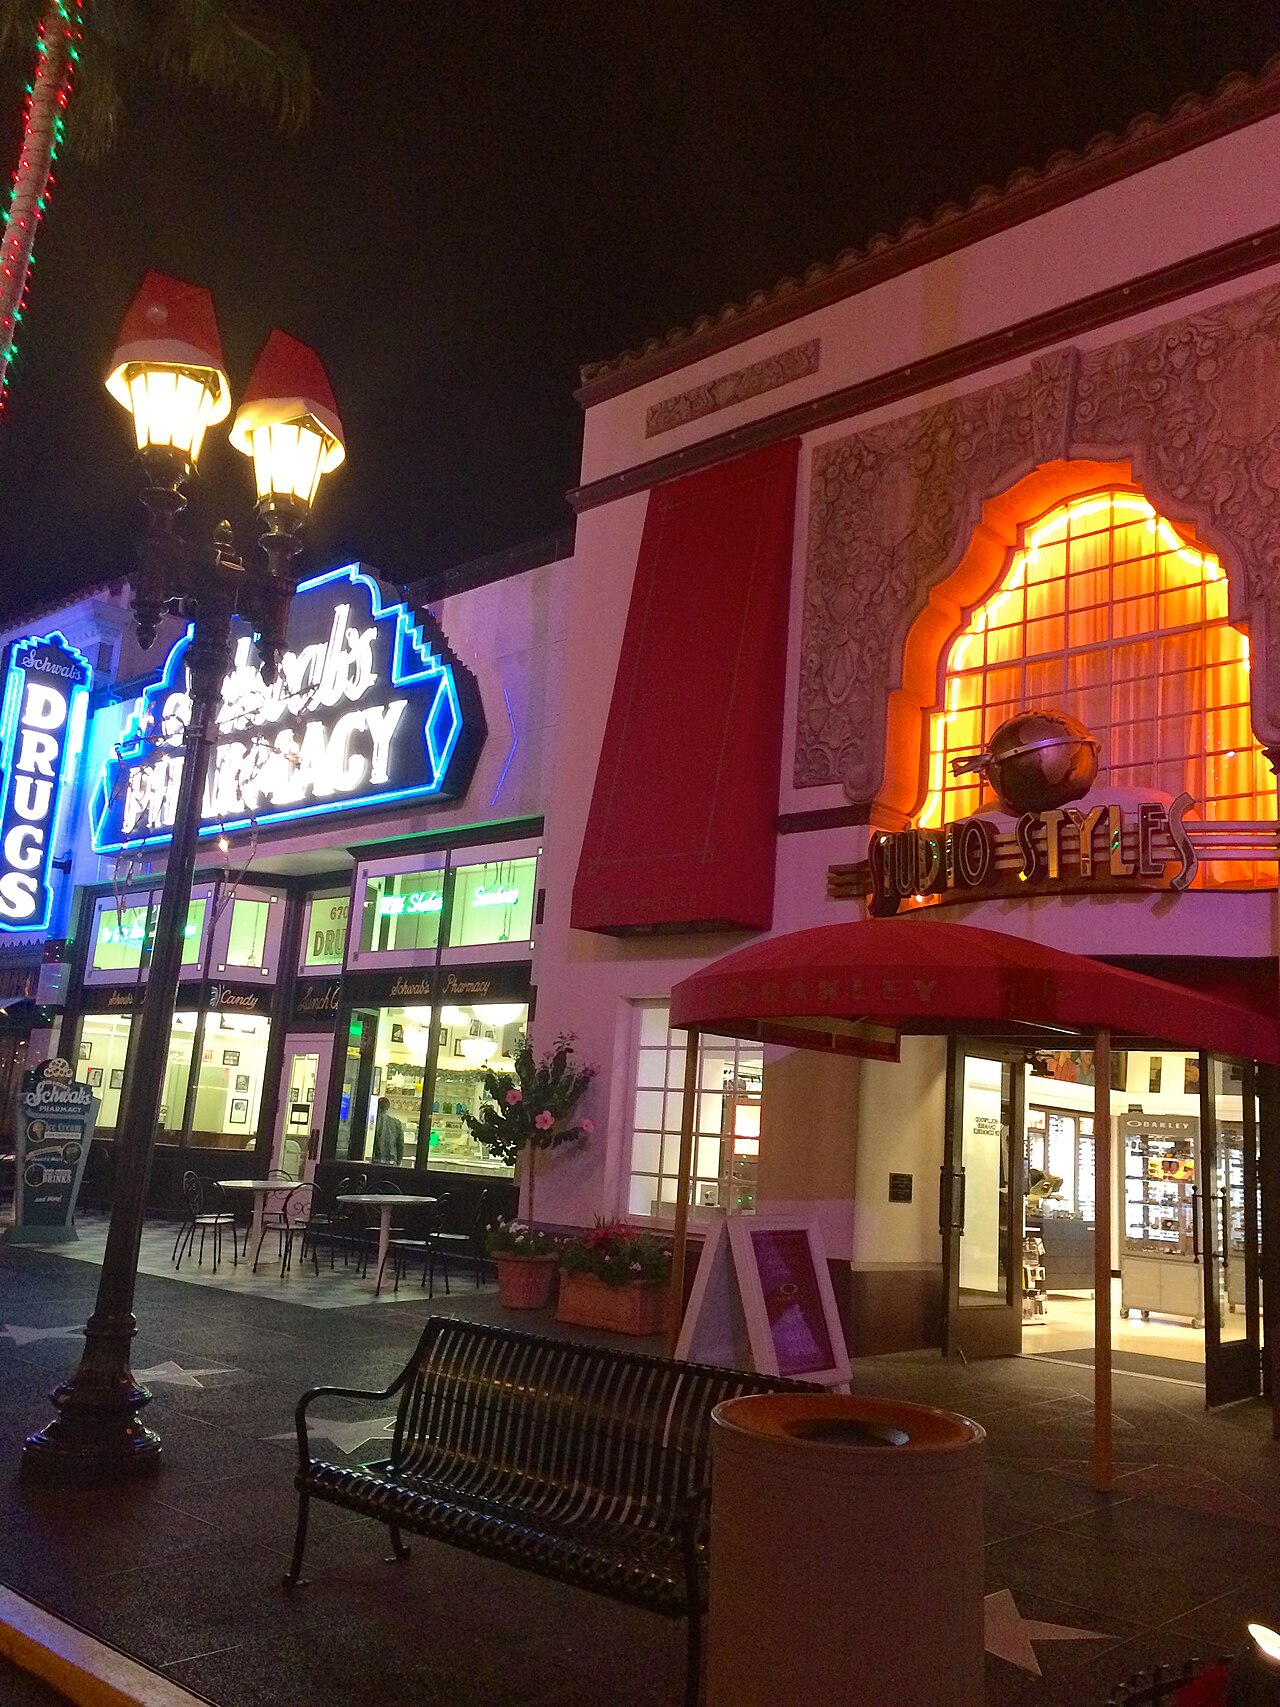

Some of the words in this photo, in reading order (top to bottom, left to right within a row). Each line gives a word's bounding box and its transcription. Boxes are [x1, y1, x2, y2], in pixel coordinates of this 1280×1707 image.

[21, 649, 83, 682] Schwab's
[0, 682, 67, 919] DRUGS
[867, 817, 992, 917] STUDIO
[1015, 791, 1199, 891] STYLES
[389, 976, 430, 997] Schwab's
[442, 974, 491, 996] Pharmacy
[220, 988, 259, 1010] Candy
[23, 1081, 92, 1107] Schwab's
[39, 1105, 82, 1113] PHARMACY
[1143, 1121, 1189, 1130] OAKLEY
